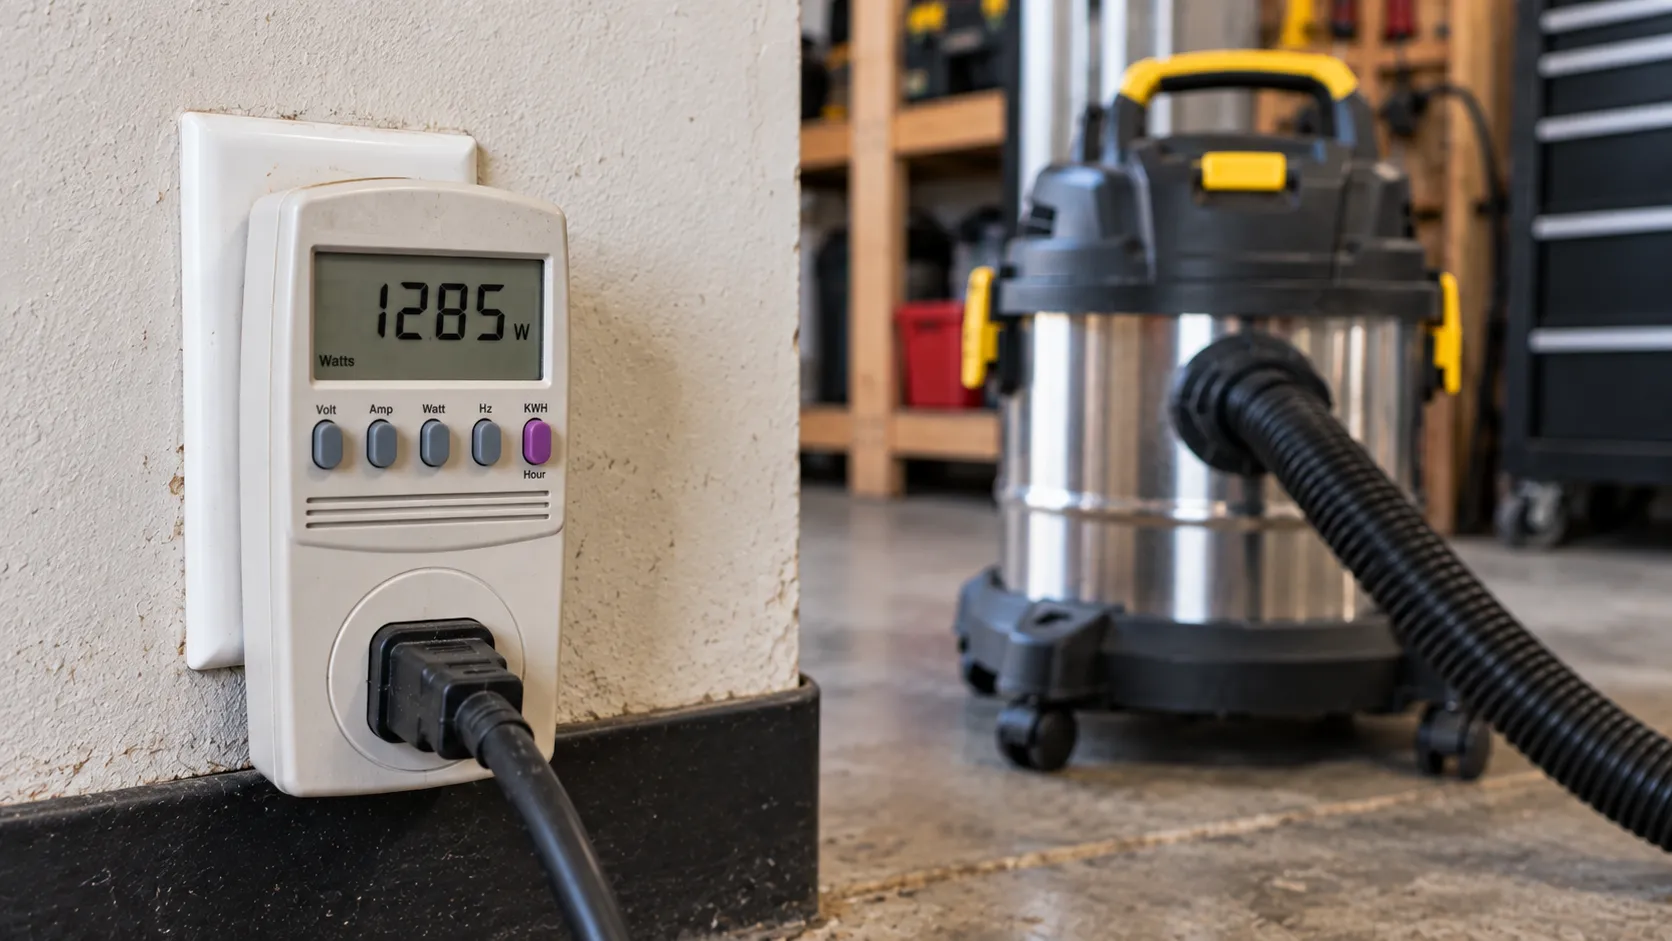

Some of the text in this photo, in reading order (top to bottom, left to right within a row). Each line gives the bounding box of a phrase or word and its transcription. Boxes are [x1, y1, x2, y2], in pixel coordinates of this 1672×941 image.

[377, 282, 530, 341] 1285 W
[319, 354, 355, 368] Watts
[316, 404, 337, 415] Volt
[369, 404, 394, 416] Amp
[422, 404, 446, 414] Watt
[479, 403, 493, 414] Hz
[524, 403, 548, 413] KWH
[523, 469, 546, 480] Hour
